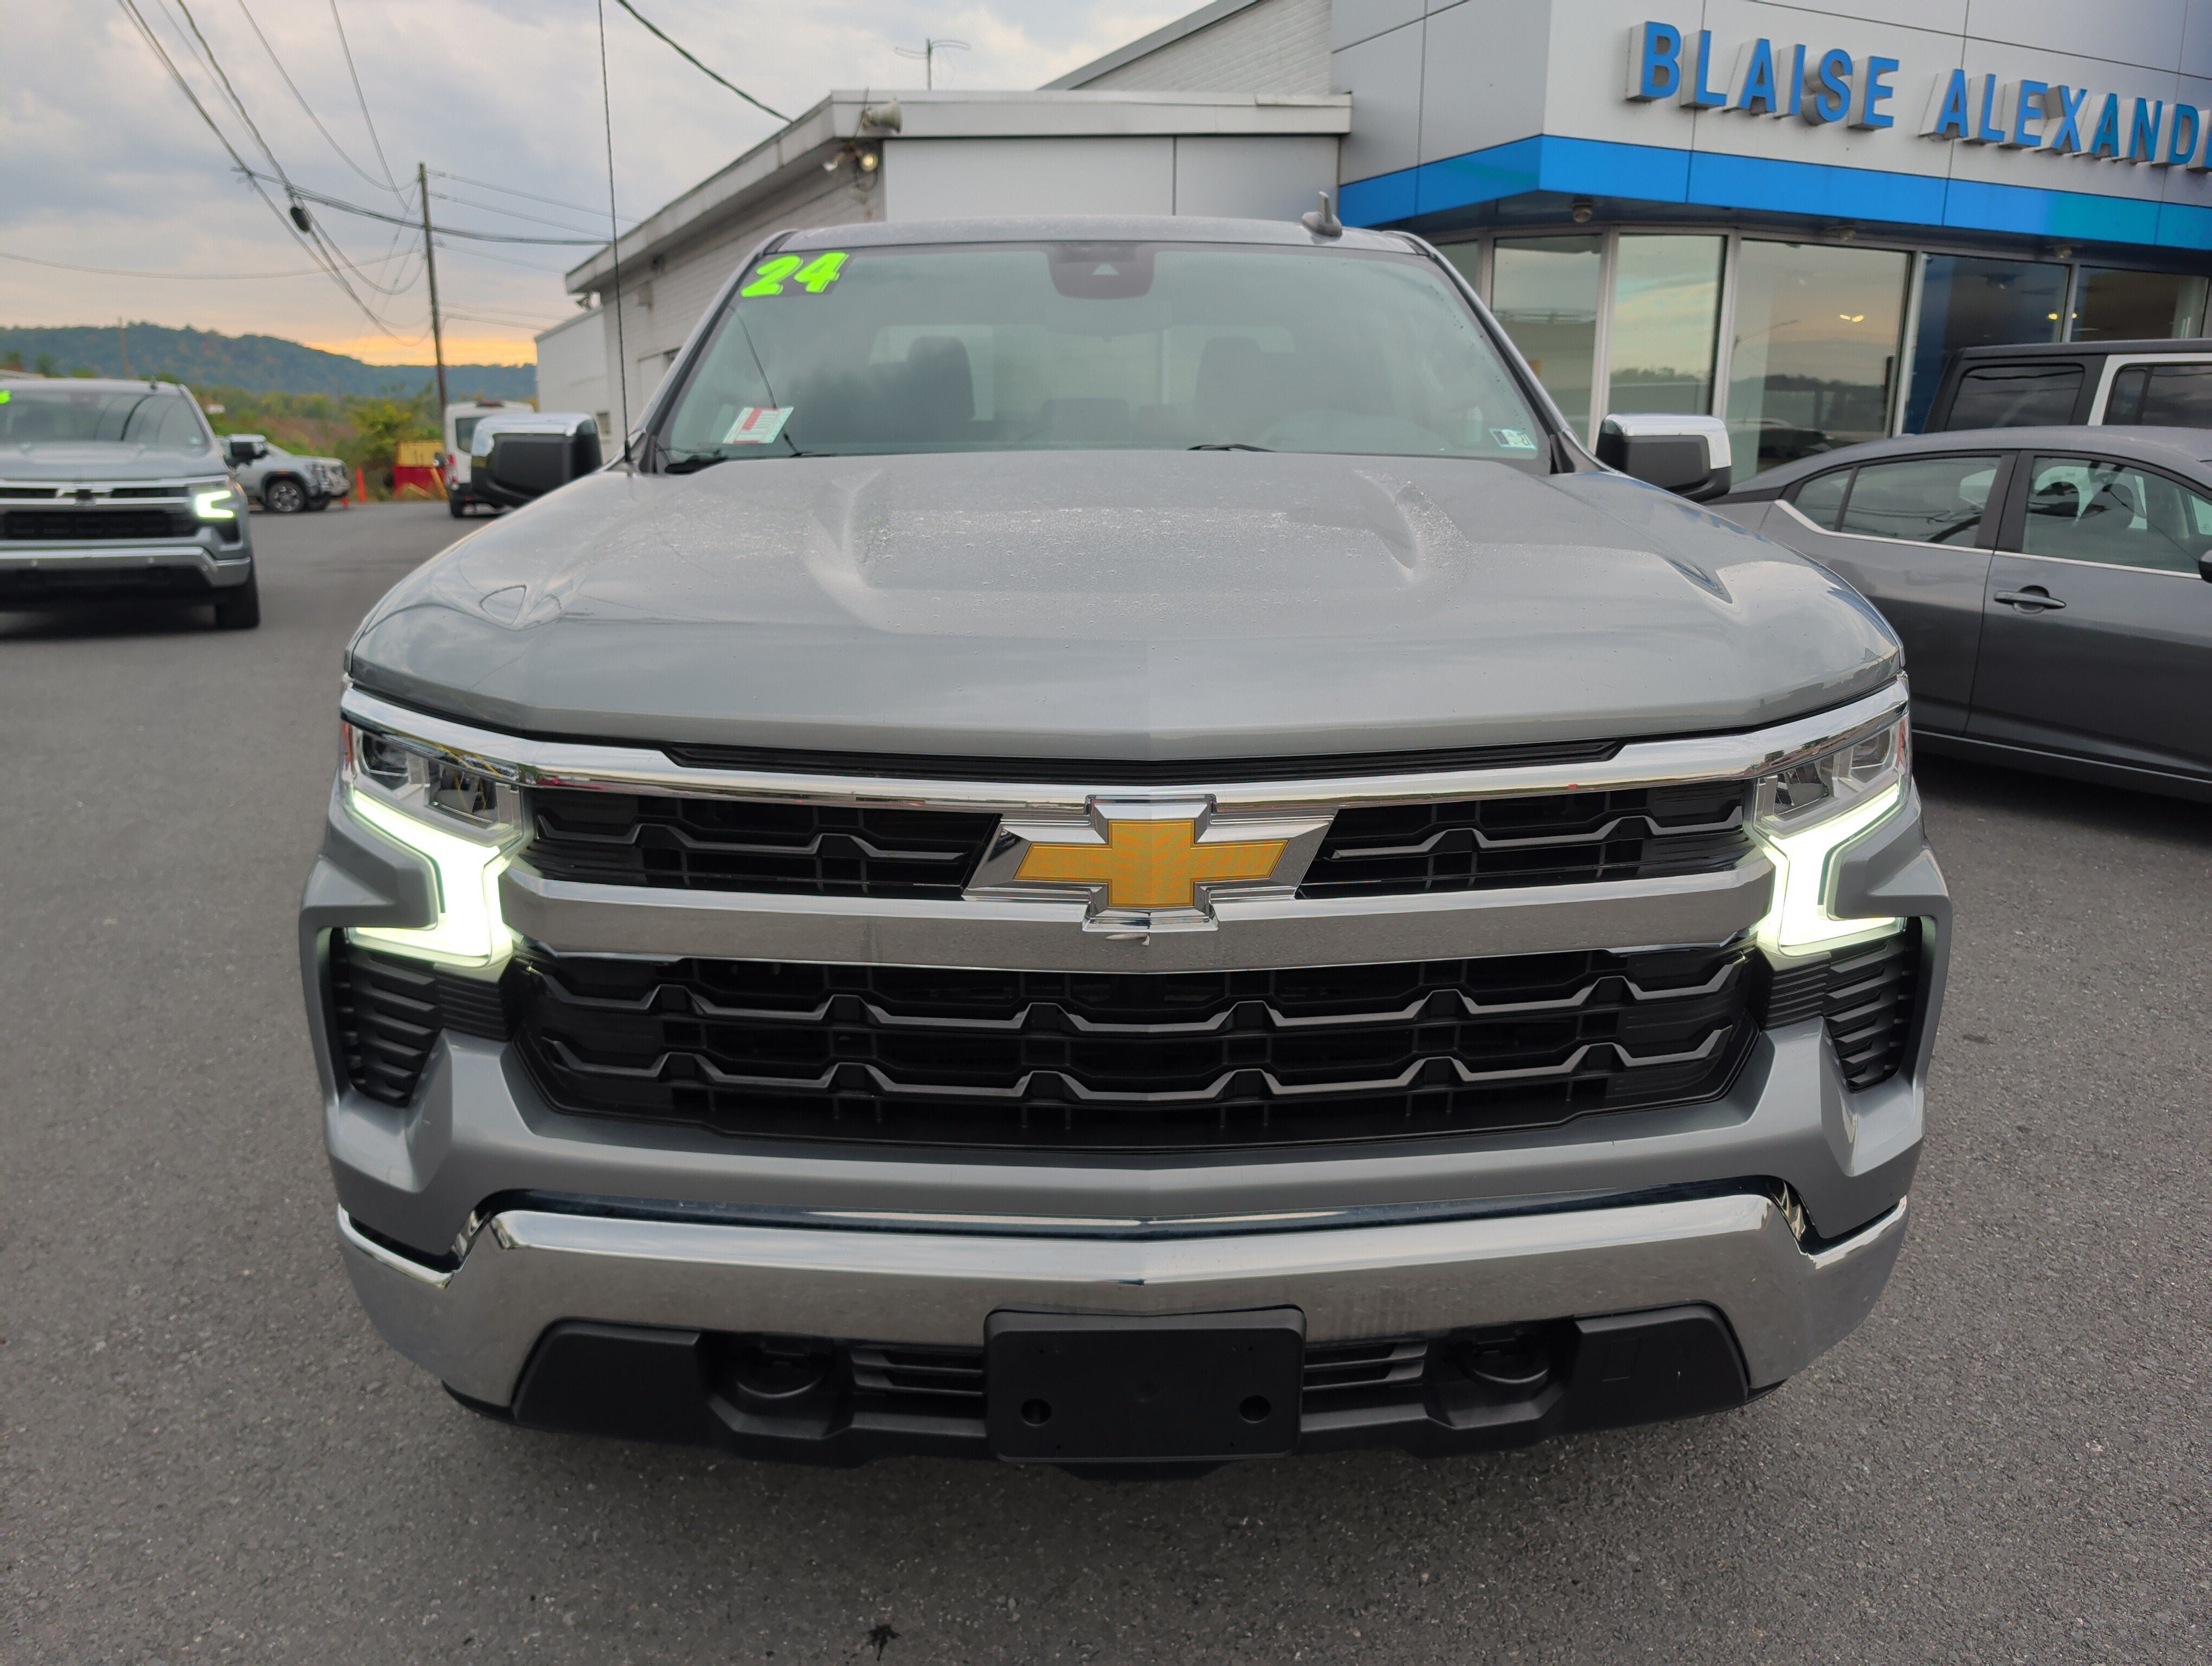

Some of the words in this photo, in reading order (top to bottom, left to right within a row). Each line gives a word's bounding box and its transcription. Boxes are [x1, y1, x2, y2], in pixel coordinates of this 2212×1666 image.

[1638, 21, 1900, 128] BLAISE
[1933, 68, 2212, 169] ALEXAND
[741, 252, 849, 297] 24
